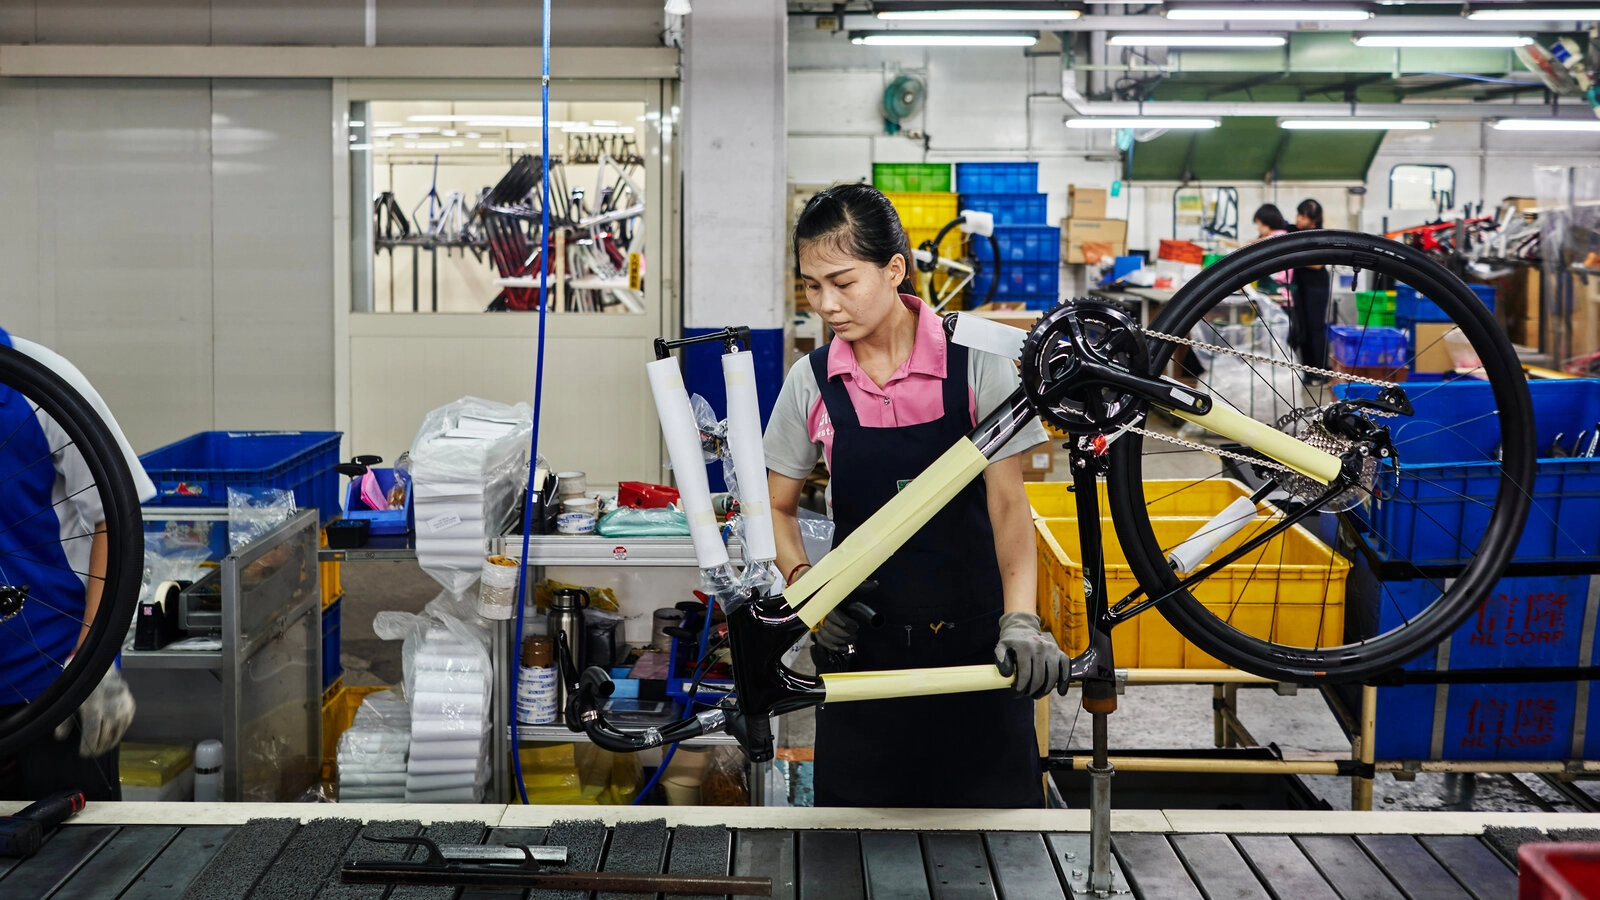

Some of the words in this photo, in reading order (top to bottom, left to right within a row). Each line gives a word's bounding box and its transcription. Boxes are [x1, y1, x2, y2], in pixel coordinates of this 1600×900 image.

[1477, 592, 1568, 630] 信隆
[1470, 632, 1498, 646] HL
[1504, 631, 1565, 646] CORP
[1467, 698, 1556, 734] 信隆
[1461, 735, 1487, 747] HL
[1494, 734, 1552, 747] CORP
